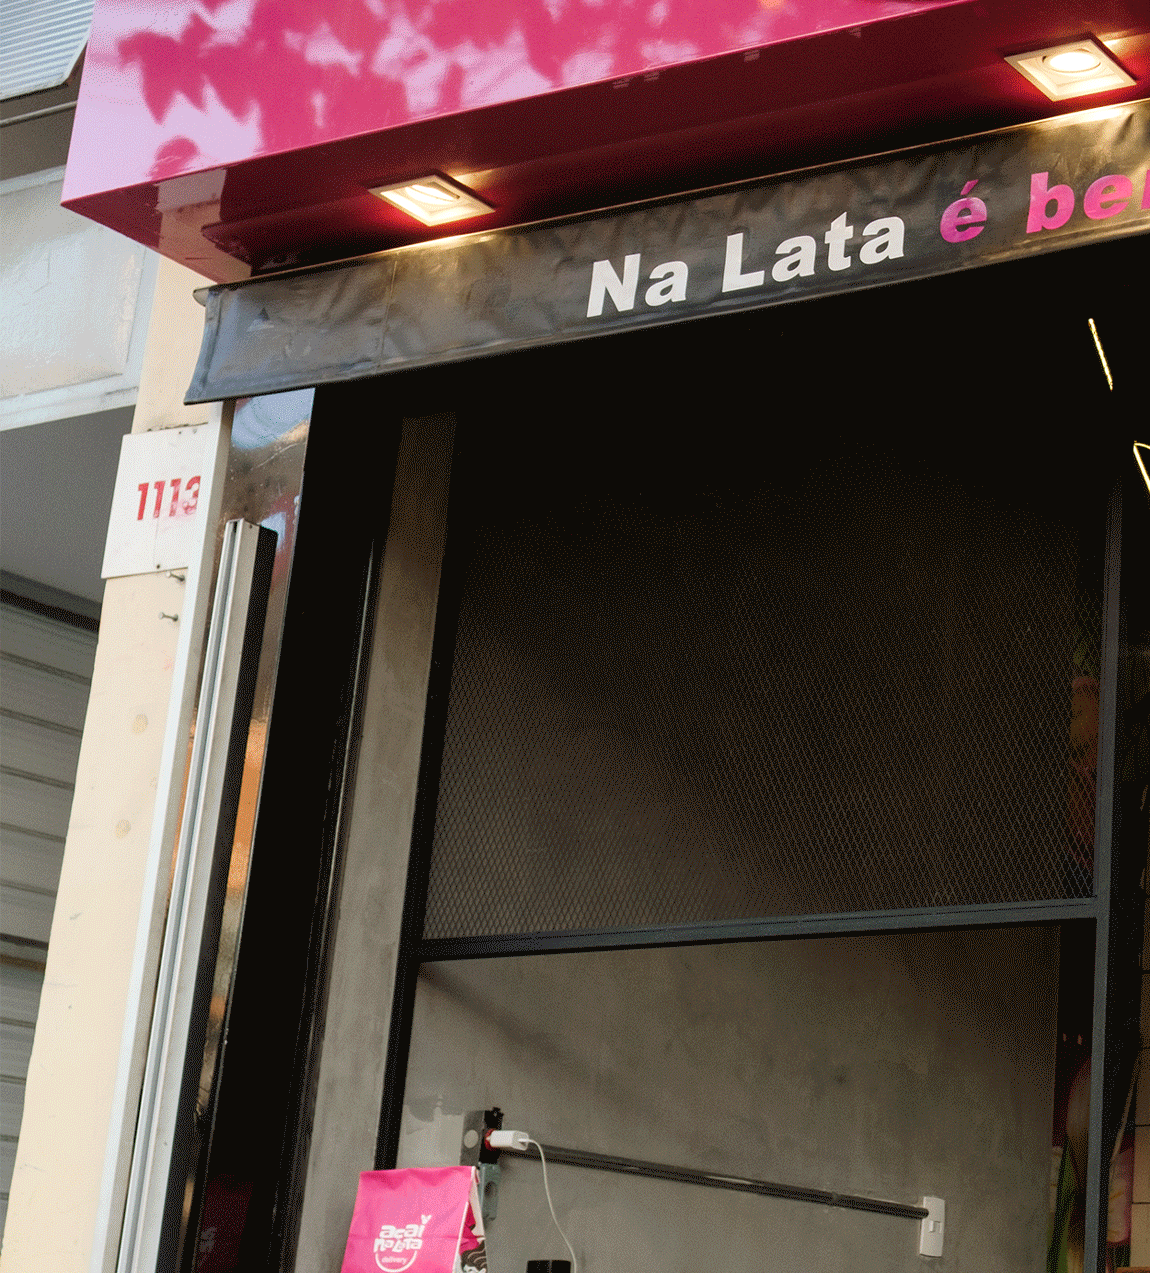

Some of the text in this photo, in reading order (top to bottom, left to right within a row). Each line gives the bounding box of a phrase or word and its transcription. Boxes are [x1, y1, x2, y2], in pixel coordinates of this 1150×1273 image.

[585, 254, 689, 319] Na
[722, 210, 905, 294] Lata
[939, 182, 986, 245] é
